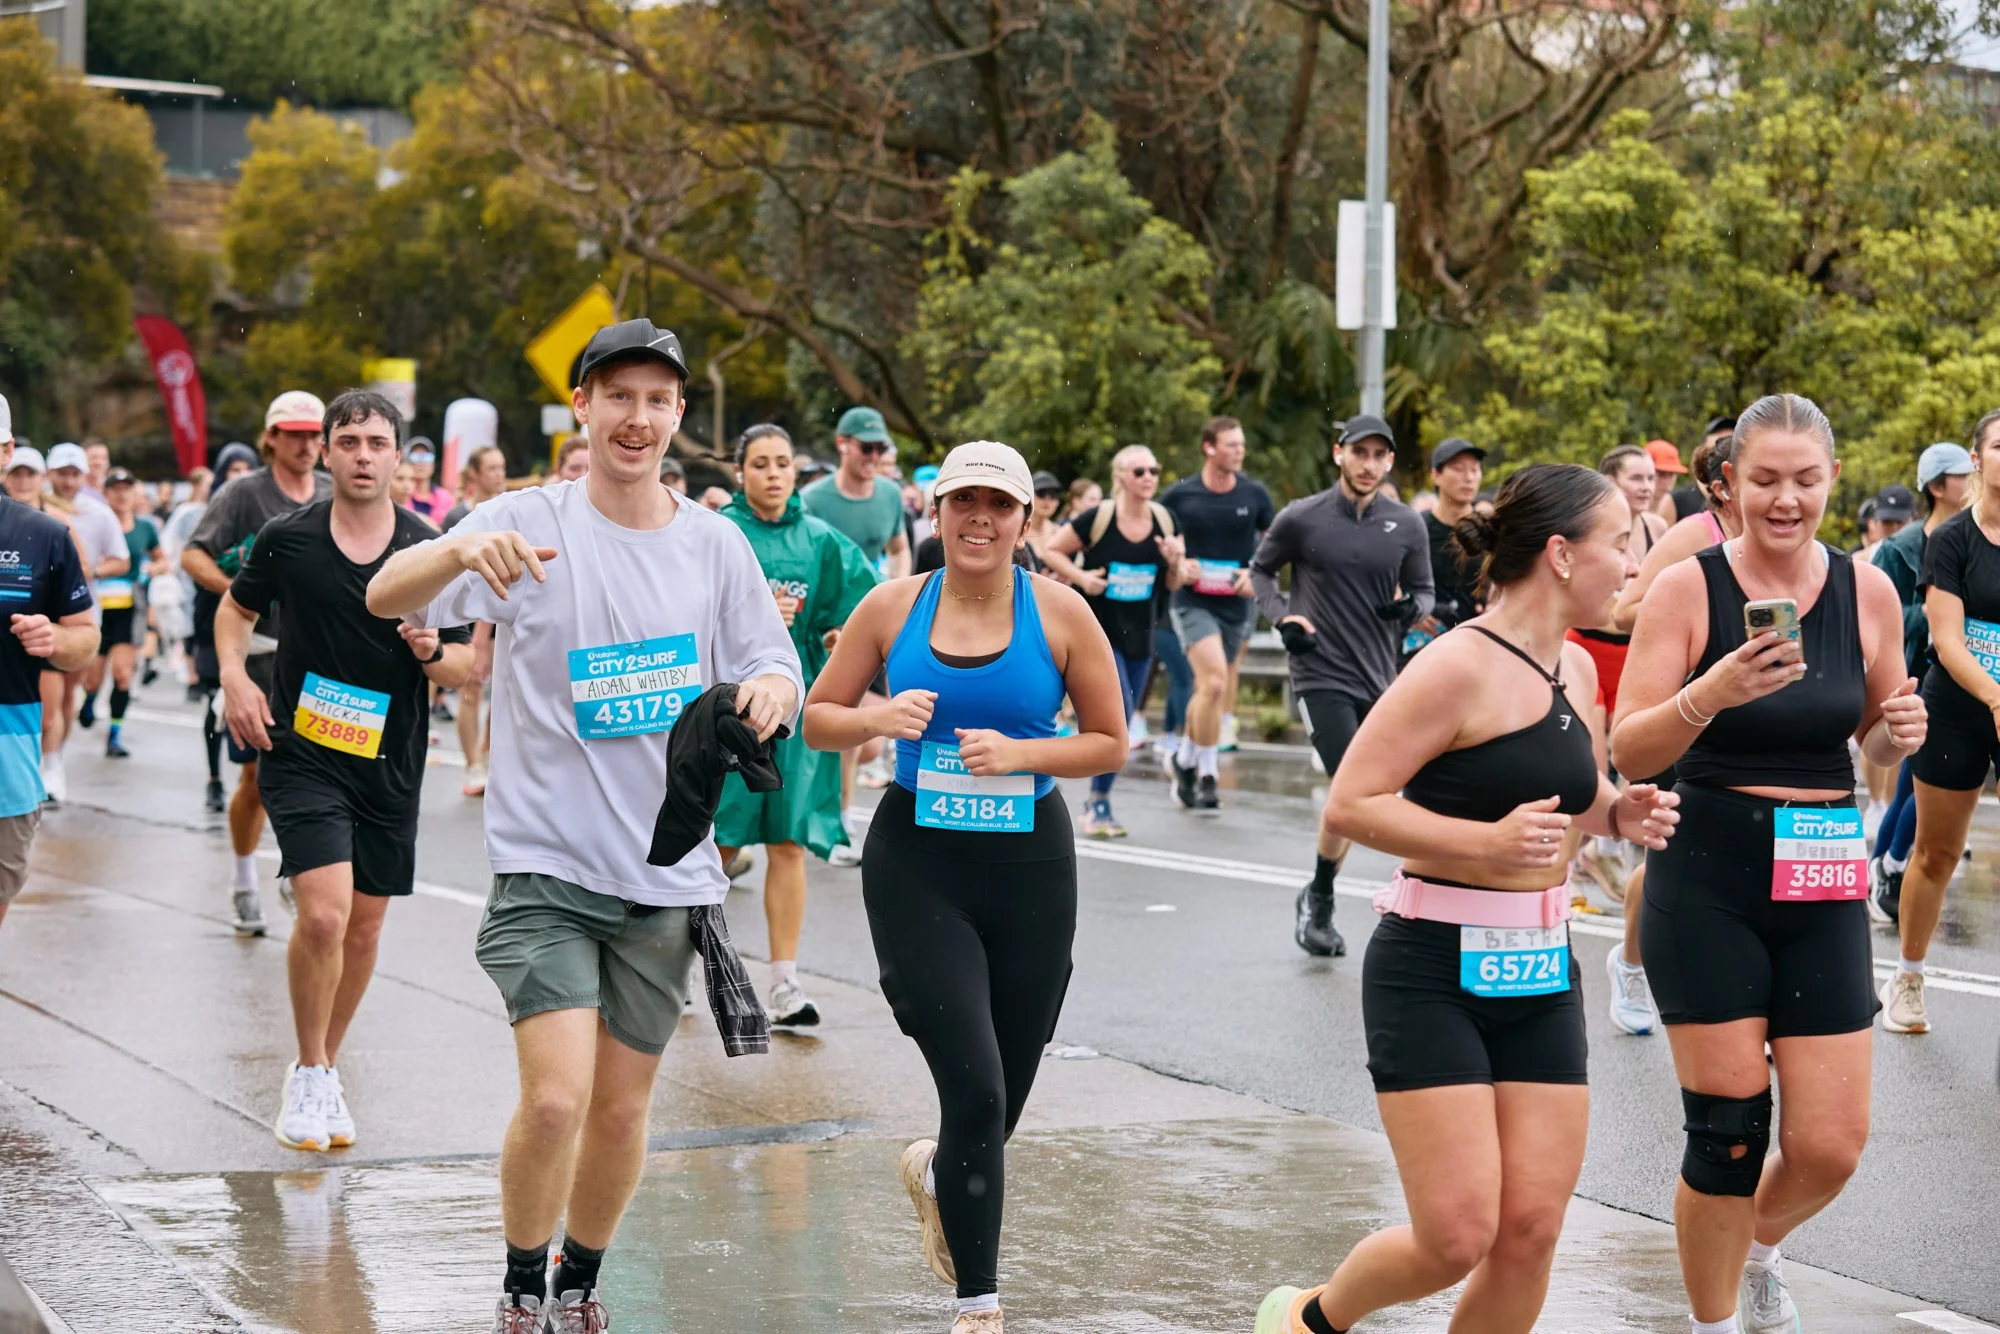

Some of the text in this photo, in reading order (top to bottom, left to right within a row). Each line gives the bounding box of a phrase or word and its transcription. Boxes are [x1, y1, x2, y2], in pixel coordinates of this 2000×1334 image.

[588, 650, 678, 674] CITY2SURF
[588, 666, 688, 698] AIDAN WHITBY
[315, 686, 378, 710] CITY2SURF
[594, 692, 683, 725] 43179
[314, 700, 360, 723] MICKA
[306, 713, 369, 745] 73889
[635, 722, 657, 730] CALLING
[931, 795, 1015, 820] 43184
[1793, 820, 1858, 837] CITY2SURF
[1790, 863, 1856, 888] 35816
[1480, 951, 1560, 982] 65724
